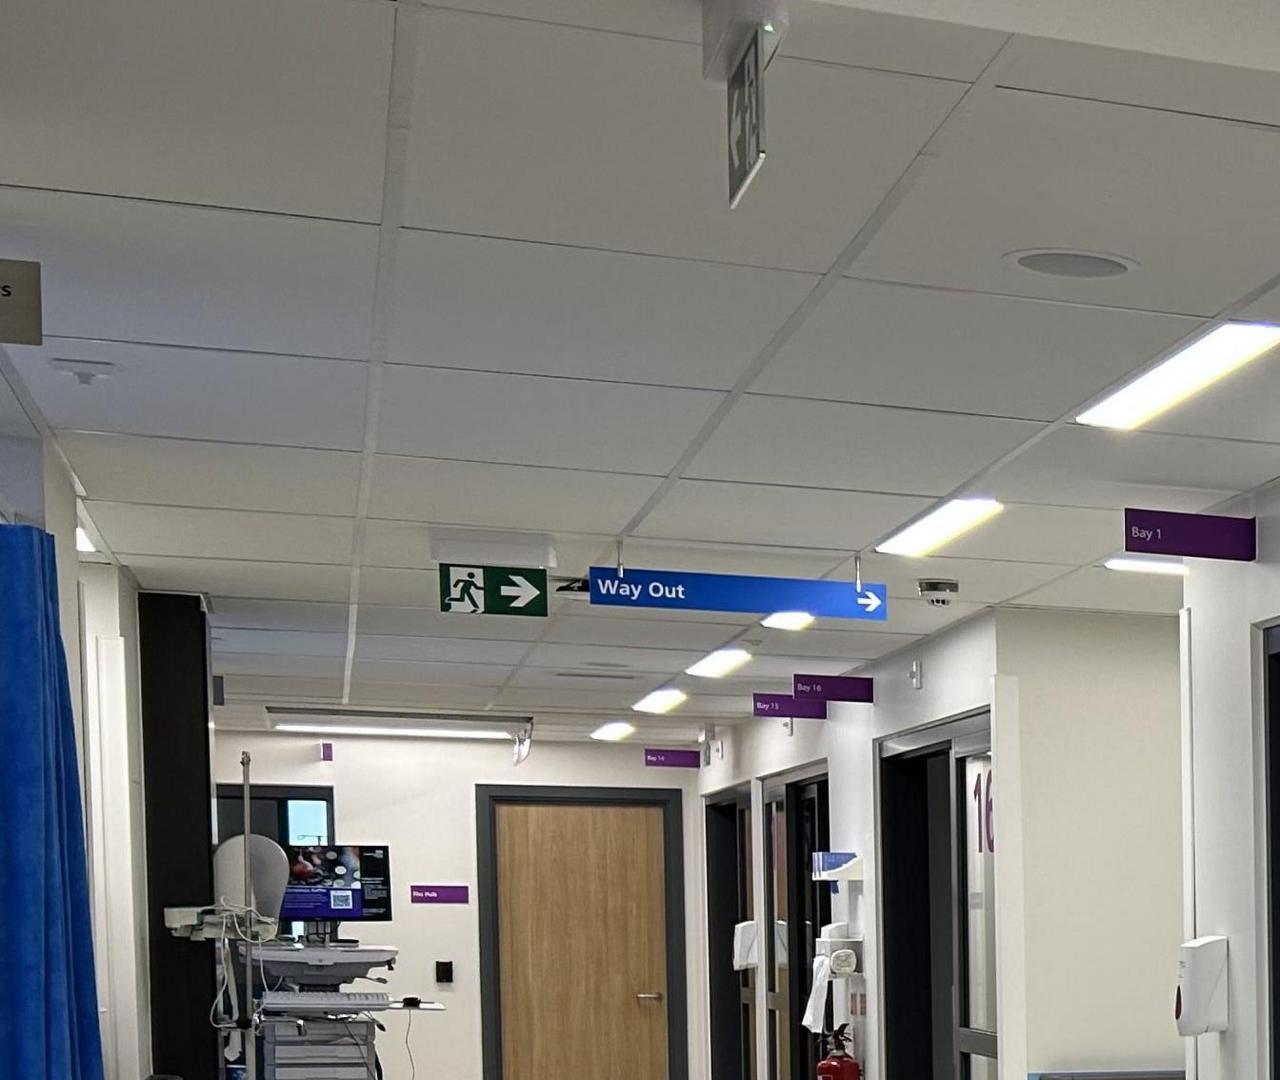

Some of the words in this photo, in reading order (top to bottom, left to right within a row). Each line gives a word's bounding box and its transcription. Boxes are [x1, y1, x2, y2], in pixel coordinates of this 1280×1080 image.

[1131, 526, 1153, 541] Bay
[1156, 528, 1161, 540] 1
[598, 579, 642, 601] Way
[648, 581, 685, 599] Out
